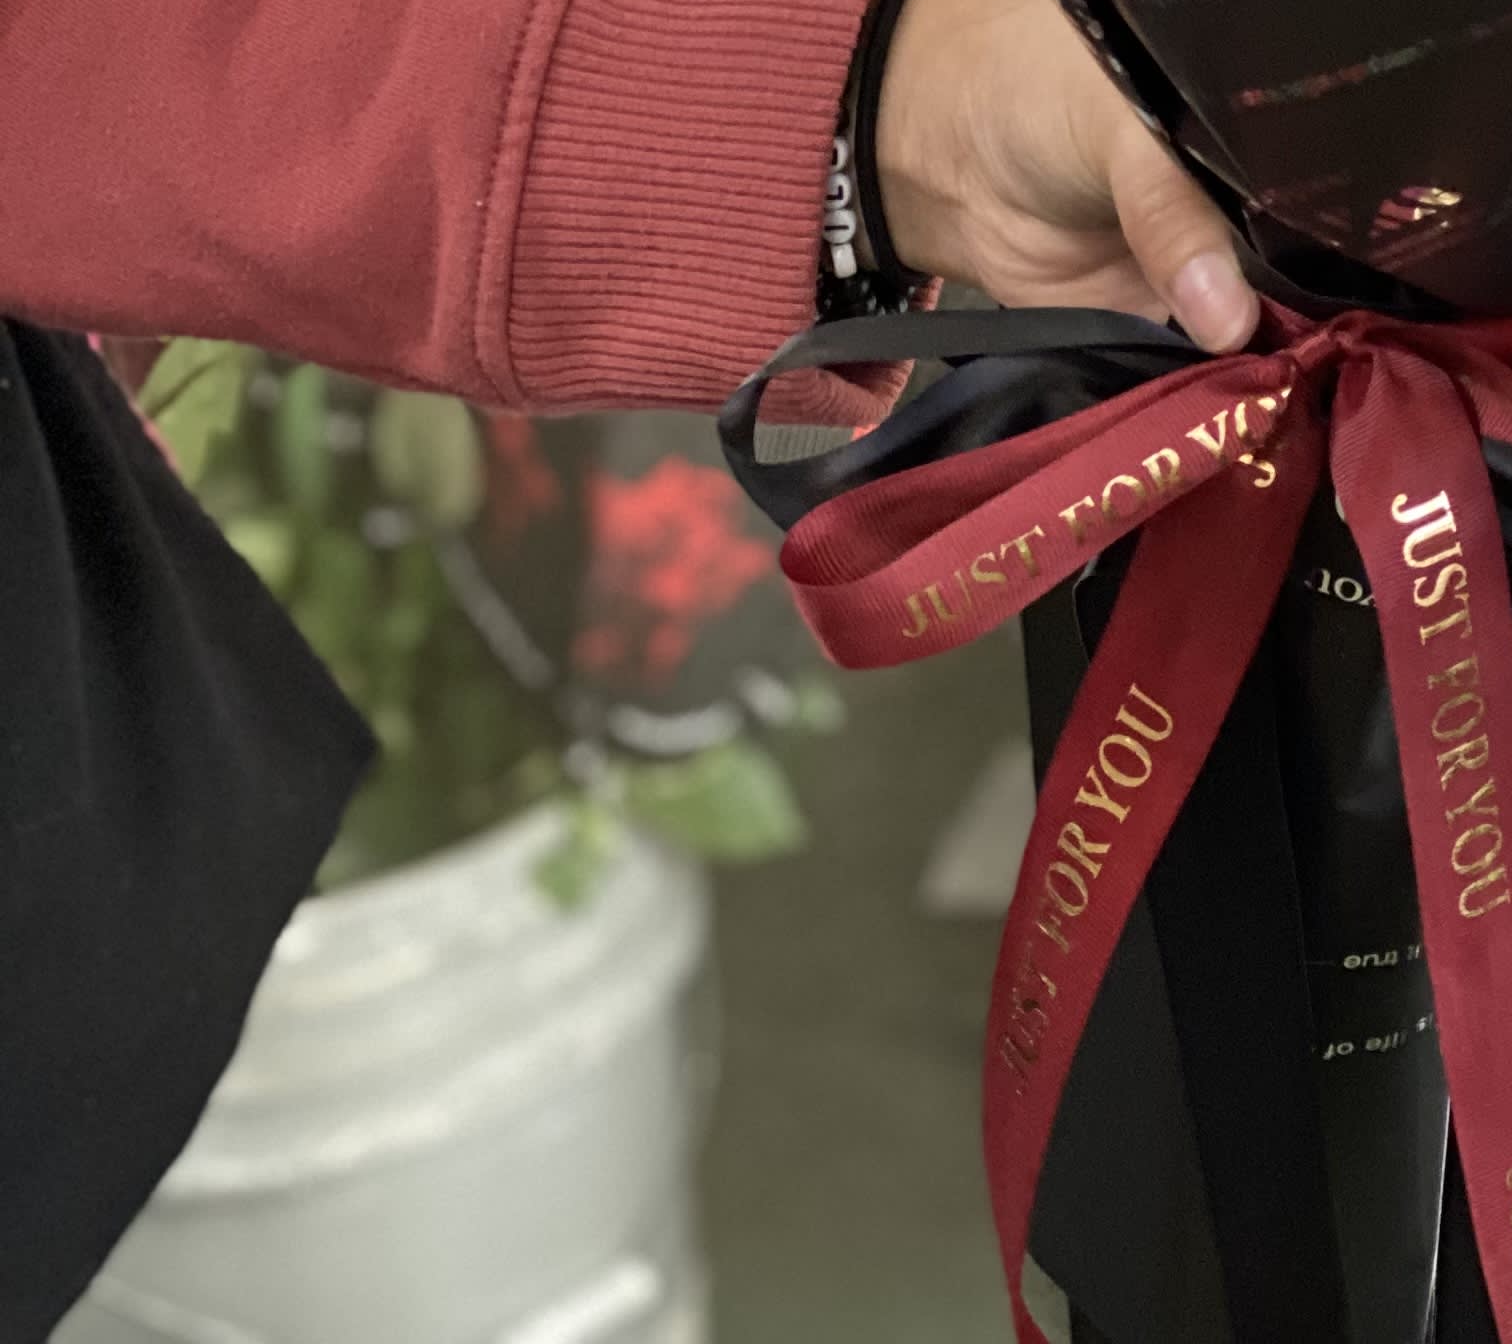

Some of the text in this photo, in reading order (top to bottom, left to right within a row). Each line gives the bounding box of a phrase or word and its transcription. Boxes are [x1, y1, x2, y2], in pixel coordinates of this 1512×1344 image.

[902, 525, 1045, 639] JUST
[1058, 447, 1184, 548] FOR
[1391, 490, 1511, 919] JUST FOR YOU
[1035, 821, 1112, 955] FOR
[1074, 683, 1174, 824] YOU
[1323, 1043, 1354, 1060] of
[1343, 949, 1398, 969] true
